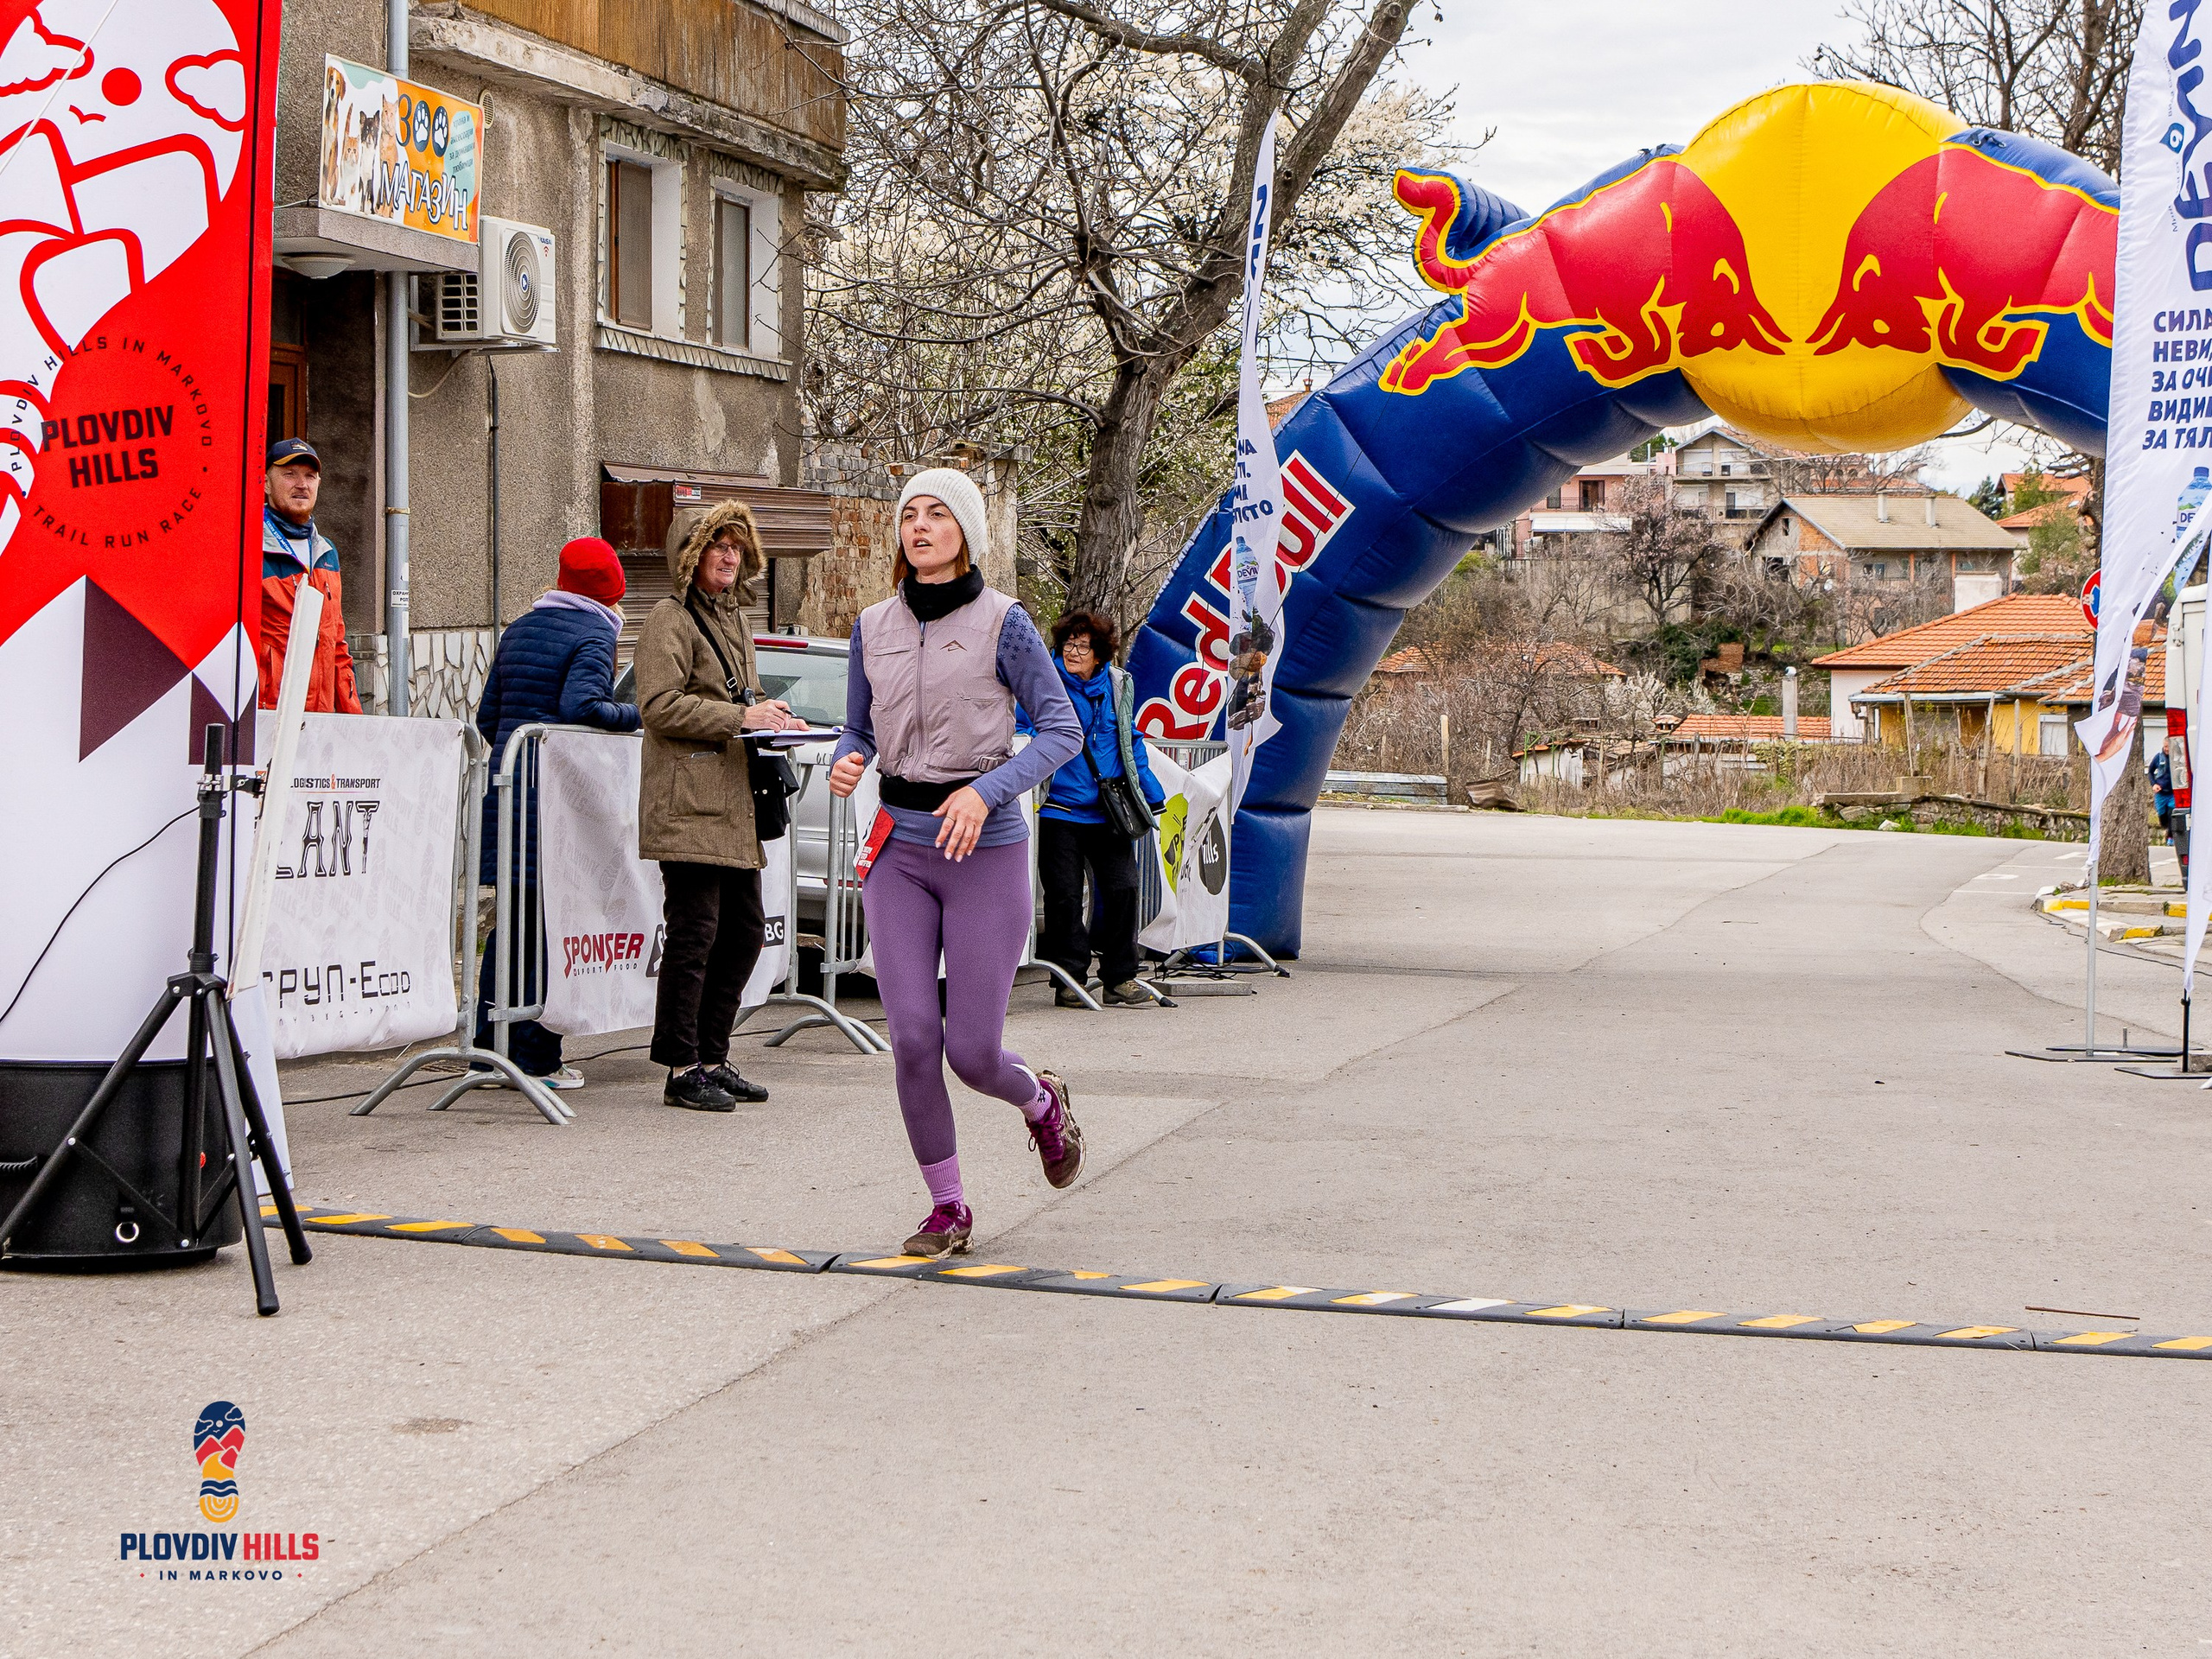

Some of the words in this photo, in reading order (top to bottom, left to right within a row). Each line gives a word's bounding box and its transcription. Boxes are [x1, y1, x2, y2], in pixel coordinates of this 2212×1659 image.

[380, 159, 467, 231] МАГАЗИН
[2153, 338, 2212, 362] НЕВИ
[2152, 370, 2177, 391] ЗА
[10, 374, 40, 472] PLOVDIV
[44, 337, 107, 371] HILLS
[123, 337, 145, 353] IN
[156, 350, 213, 447] MARKOVO
[41, 405, 174, 452] PLOVDIV
[2142, 428, 2167, 450] ЗА
[69, 448, 159, 488] HILLS
[33, 505, 89, 546] TRAIL
[105, 531, 149, 548] RUN
[160, 487, 201, 532] RACE
[290, 778, 330, 788] OGISTICS
[563, 933, 645, 979] SPONSER
